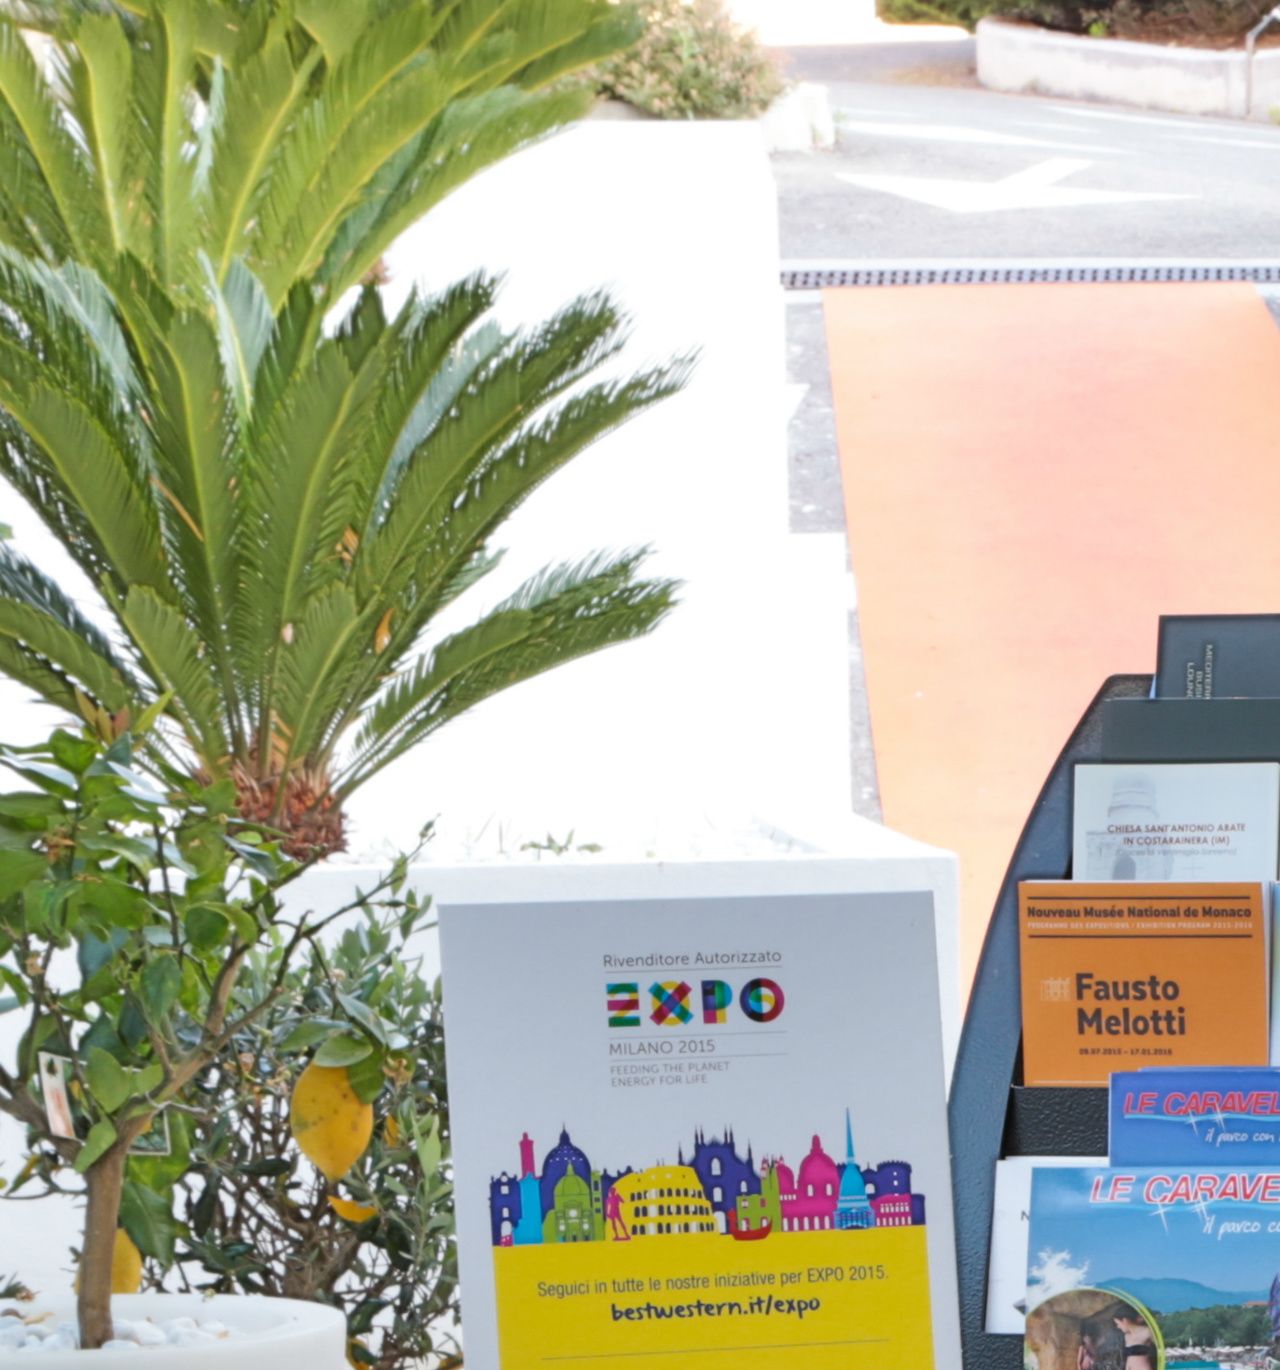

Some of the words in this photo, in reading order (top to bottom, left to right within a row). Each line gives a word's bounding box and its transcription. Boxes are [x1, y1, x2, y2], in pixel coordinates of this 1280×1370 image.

[1107, 825, 1141, 833] CHIESA
[1144, 824, 1215, 833] SANT'ANTONIO
[1217, 823, 1246, 832] ABATE
[1123, 837, 1133, 845] IN
[1136, 837, 1208, 845] COSTARAINERA
[1211, 836, 1230, 846] (IM)
[1027, 906, 1080, 918] Nouveau
[1083, 904, 1124, 917] Musée
[1127, 906, 1180, 917] National
[1184, 906, 1198, 917] de
[1202, 906, 1252, 918] Monaco
[603, 953, 690, 968] Rivenditore
[694, 951, 782, 964] Autorizzato
[1076, 972, 1180, 1001] Fausto
[606, 977, 785, 1028] EXPO
[1077, 1006, 1186, 1036] Melotti
[609, 1041, 673, 1056] MILANO
[678, 1039, 716, 1054] 2015
[610, 1064, 660, 1075] FEEDING
[663, 1063, 685, 1073] THE
[688, 1061, 731, 1072] PLANET
[611, 1076, 656, 1087] ENERGY
[659, 1075, 682, 1085] FOR
[686, 1074, 708, 1084] LIFE
[1123, 1092, 1160, 1115] LE
[1205, 1128, 1213, 1142] il
[1216, 1130, 1249, 1147] parco
[1252, 1131, 1275, 1143] con
[1089, 1174, 1136, 1203] LE
[1203, 1214, 1216, 1234] il
[1218, 1218, 1262, 1240] parco
[537, 1281, 590, 1299] Seguici
[595, 1280, 607, 1293] in
[611, 1278, 645, 1293] tutte
[649, 1278, 661, 1291] le
[666, 1275, 709, 1290] nostre
[714, 1271, 775, 1287] iniziative
[780, 1272, 802, 1288] per
[808, 1267, 844, 1282] EXPO
[849, 1265, 889, 1281] 2015.
[611, 1295, 821, 1321] bestwestern.it/expo
